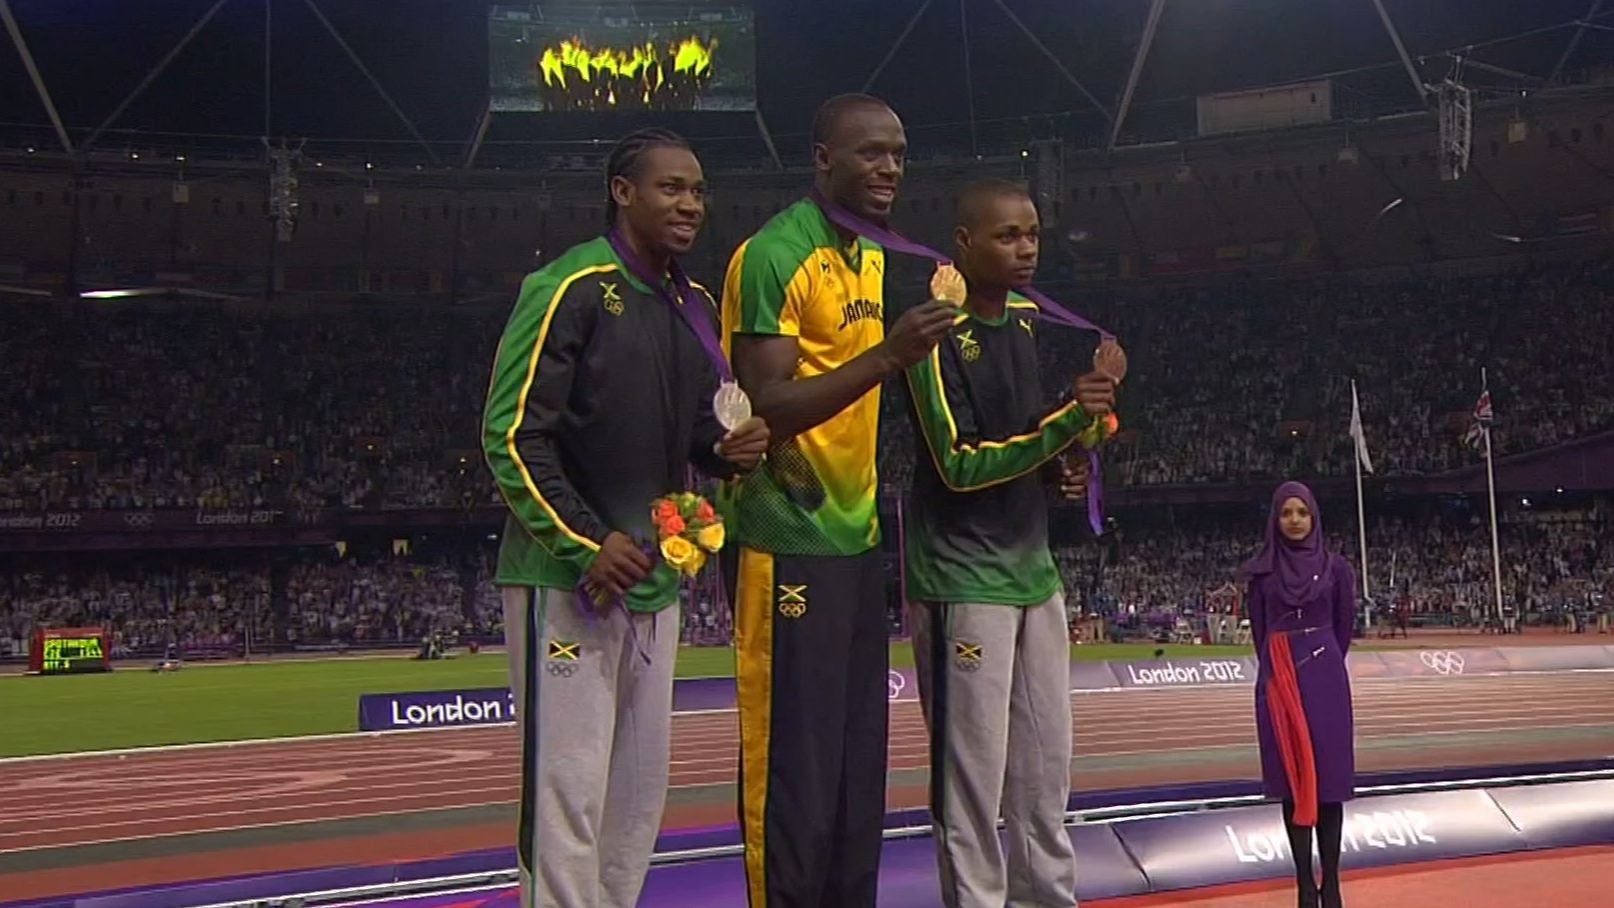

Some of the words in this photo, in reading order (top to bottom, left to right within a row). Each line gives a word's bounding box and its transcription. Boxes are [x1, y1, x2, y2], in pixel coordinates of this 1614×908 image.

[46, 512, 81, 527] 2012
[196, 510, 248, 524] London
[251, 509, 284, 524] 201
[1128, 661, 1200, 684] London
[1200, 660, 1245, 680] 2012
[391, 695, 500, 725] London
[1352, 809, 1437, 849] 2012
